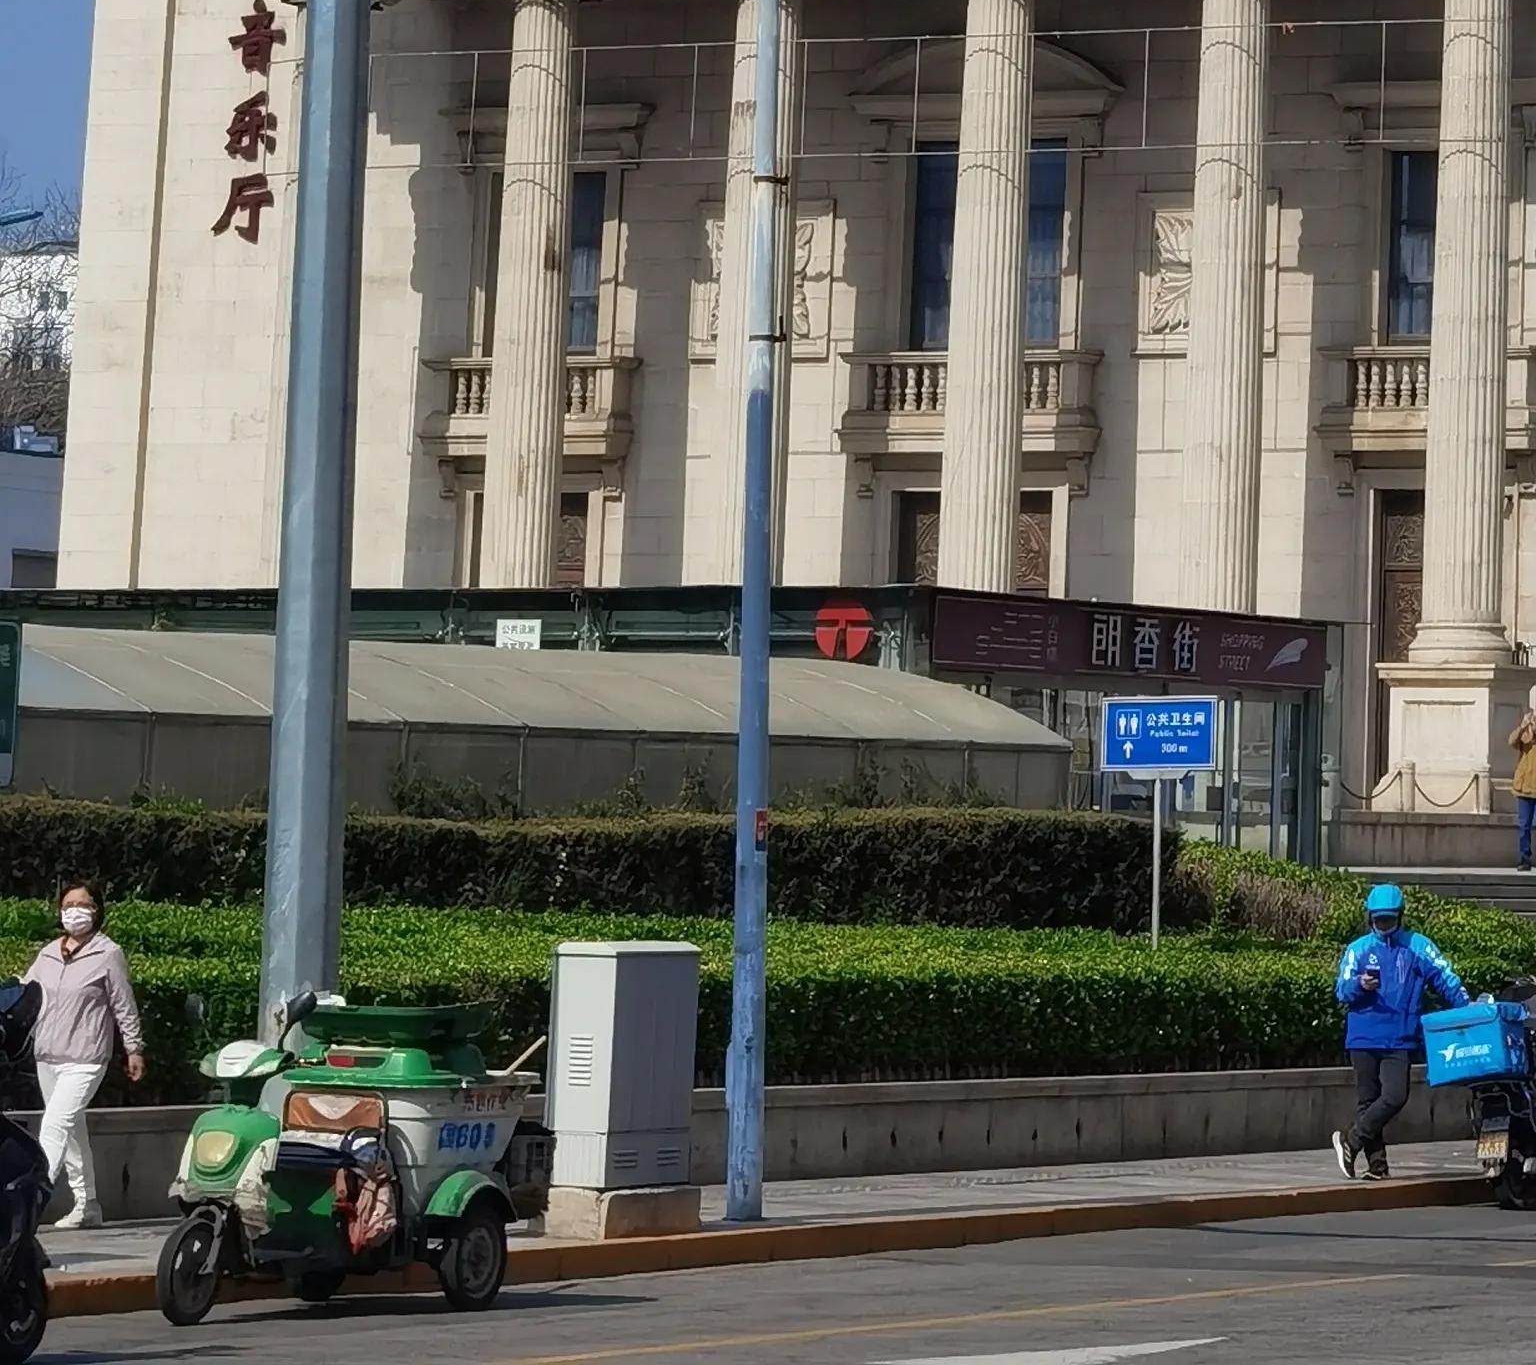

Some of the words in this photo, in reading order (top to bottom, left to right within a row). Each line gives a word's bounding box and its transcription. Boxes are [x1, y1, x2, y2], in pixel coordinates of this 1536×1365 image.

[1146, 711, 1205, 727] 公共卫生间
[1149, 730, 1174, 738] Public
